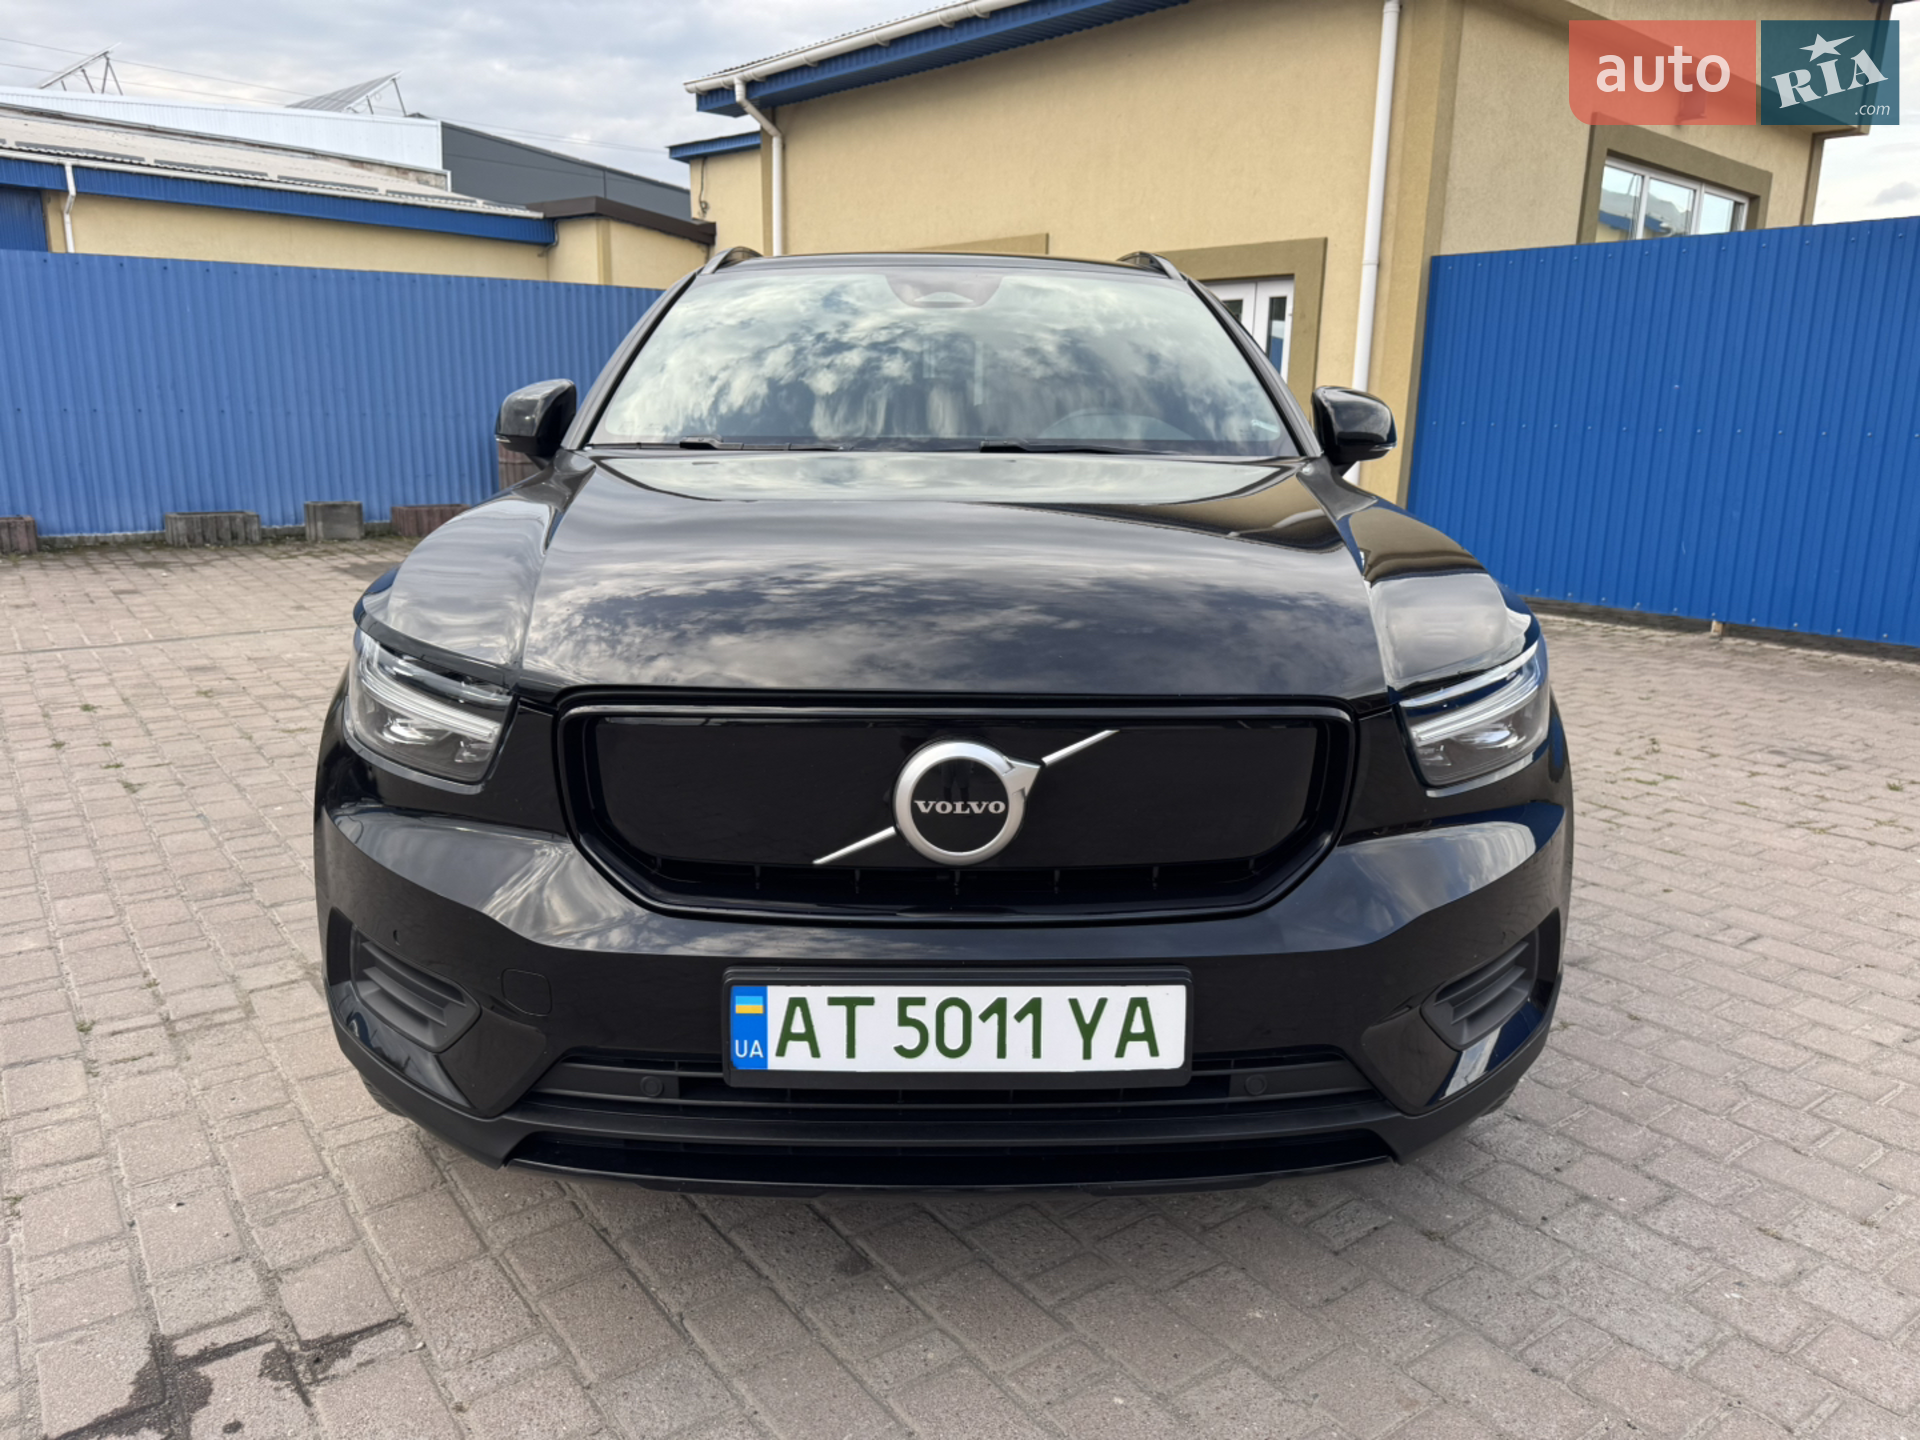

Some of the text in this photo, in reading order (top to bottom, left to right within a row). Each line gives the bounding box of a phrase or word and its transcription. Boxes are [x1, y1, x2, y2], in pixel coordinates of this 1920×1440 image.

[914, 801, 1006, 814] VOLVO
[775, 996, 1160, 1060] AT 5011 YA
[735, 1040, 764, 1058] UA
